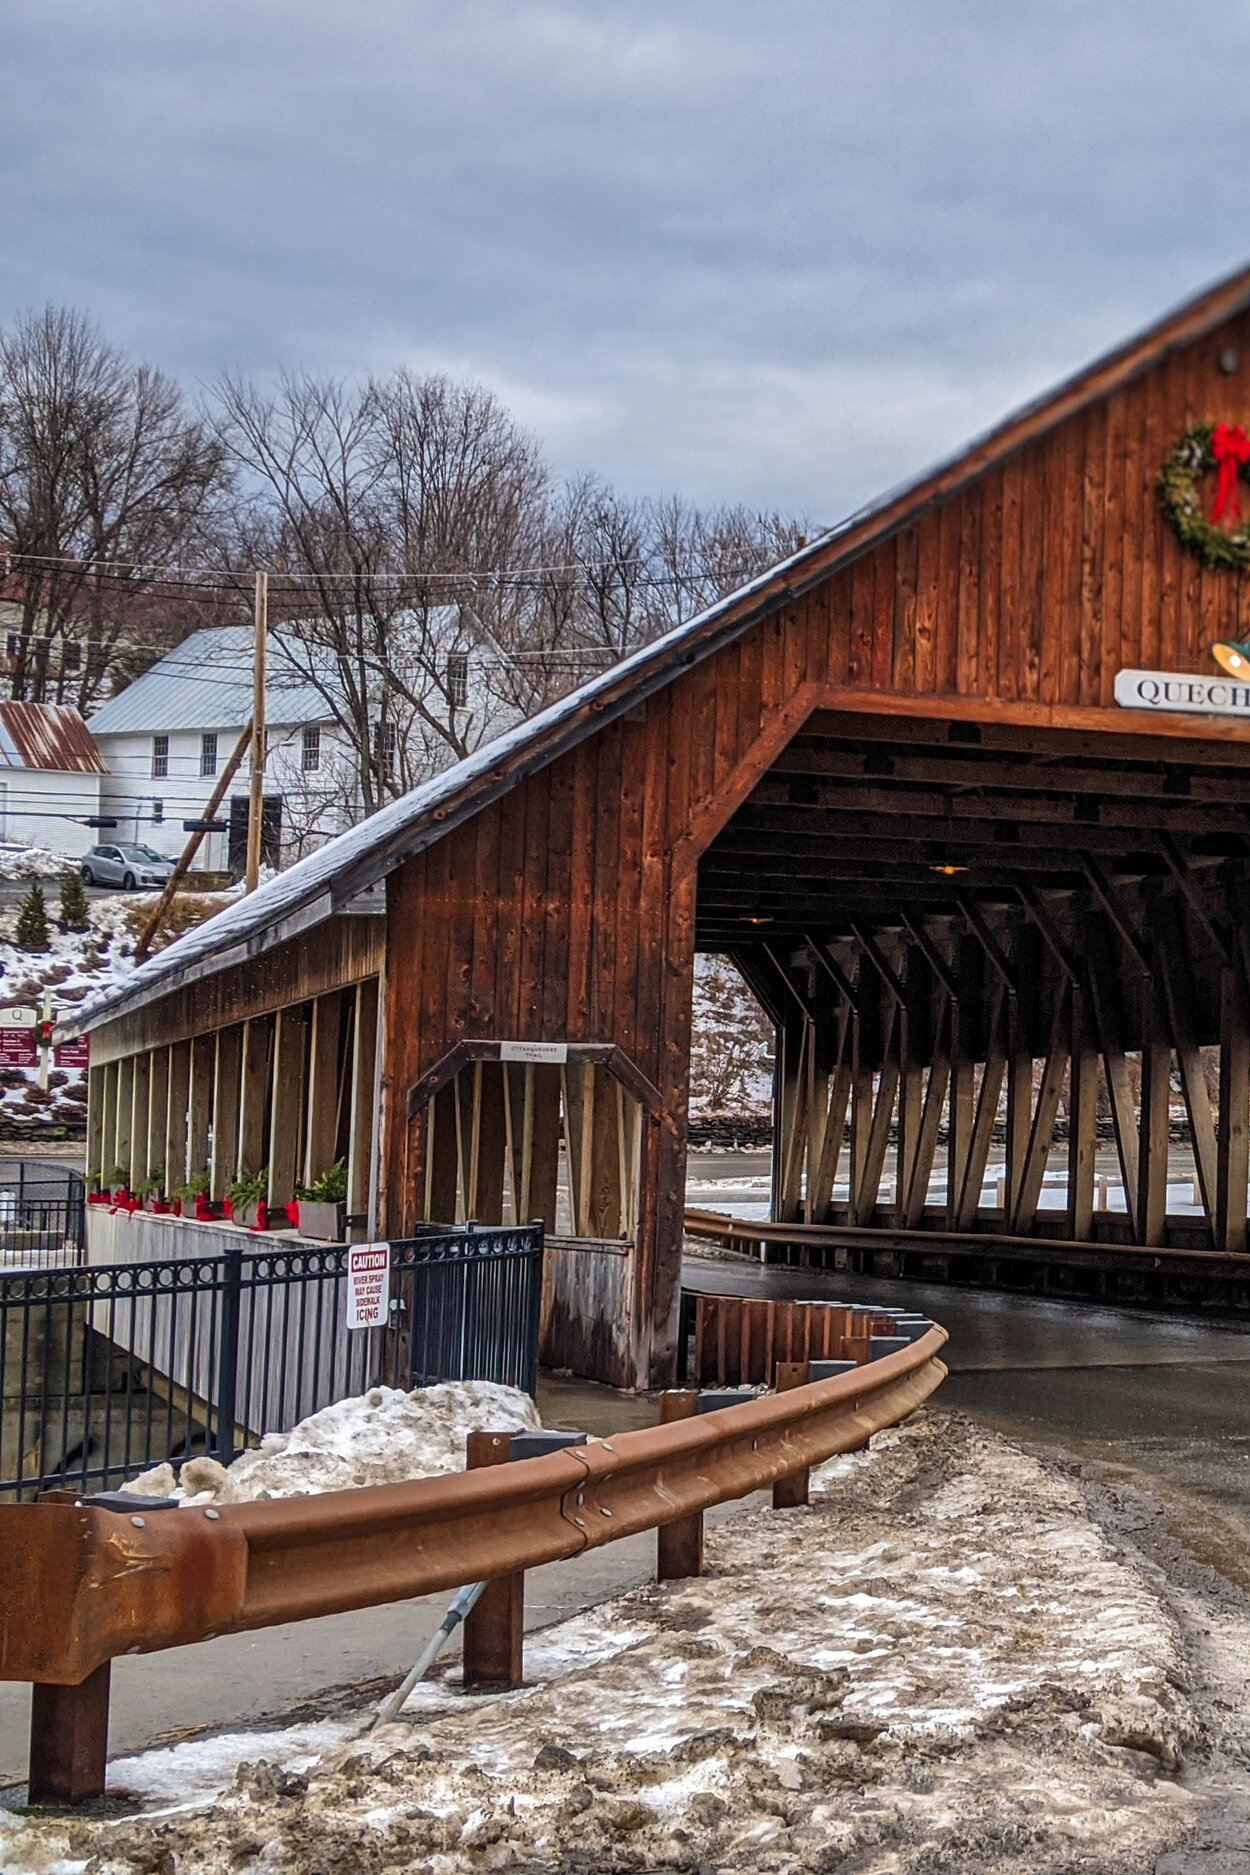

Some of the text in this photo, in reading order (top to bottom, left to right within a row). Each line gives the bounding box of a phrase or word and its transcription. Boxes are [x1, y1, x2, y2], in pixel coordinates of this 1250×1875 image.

[352, 1253, 386, 1270] CAUTION
[353, 1274, 384, 1285] RIVER SPRAY
[355, 1285, 382, 1296] MAY CAUSE
[356, 1296, 380, 1307] SIDEWALK
[356, 1307, 379, 1321] ICING
